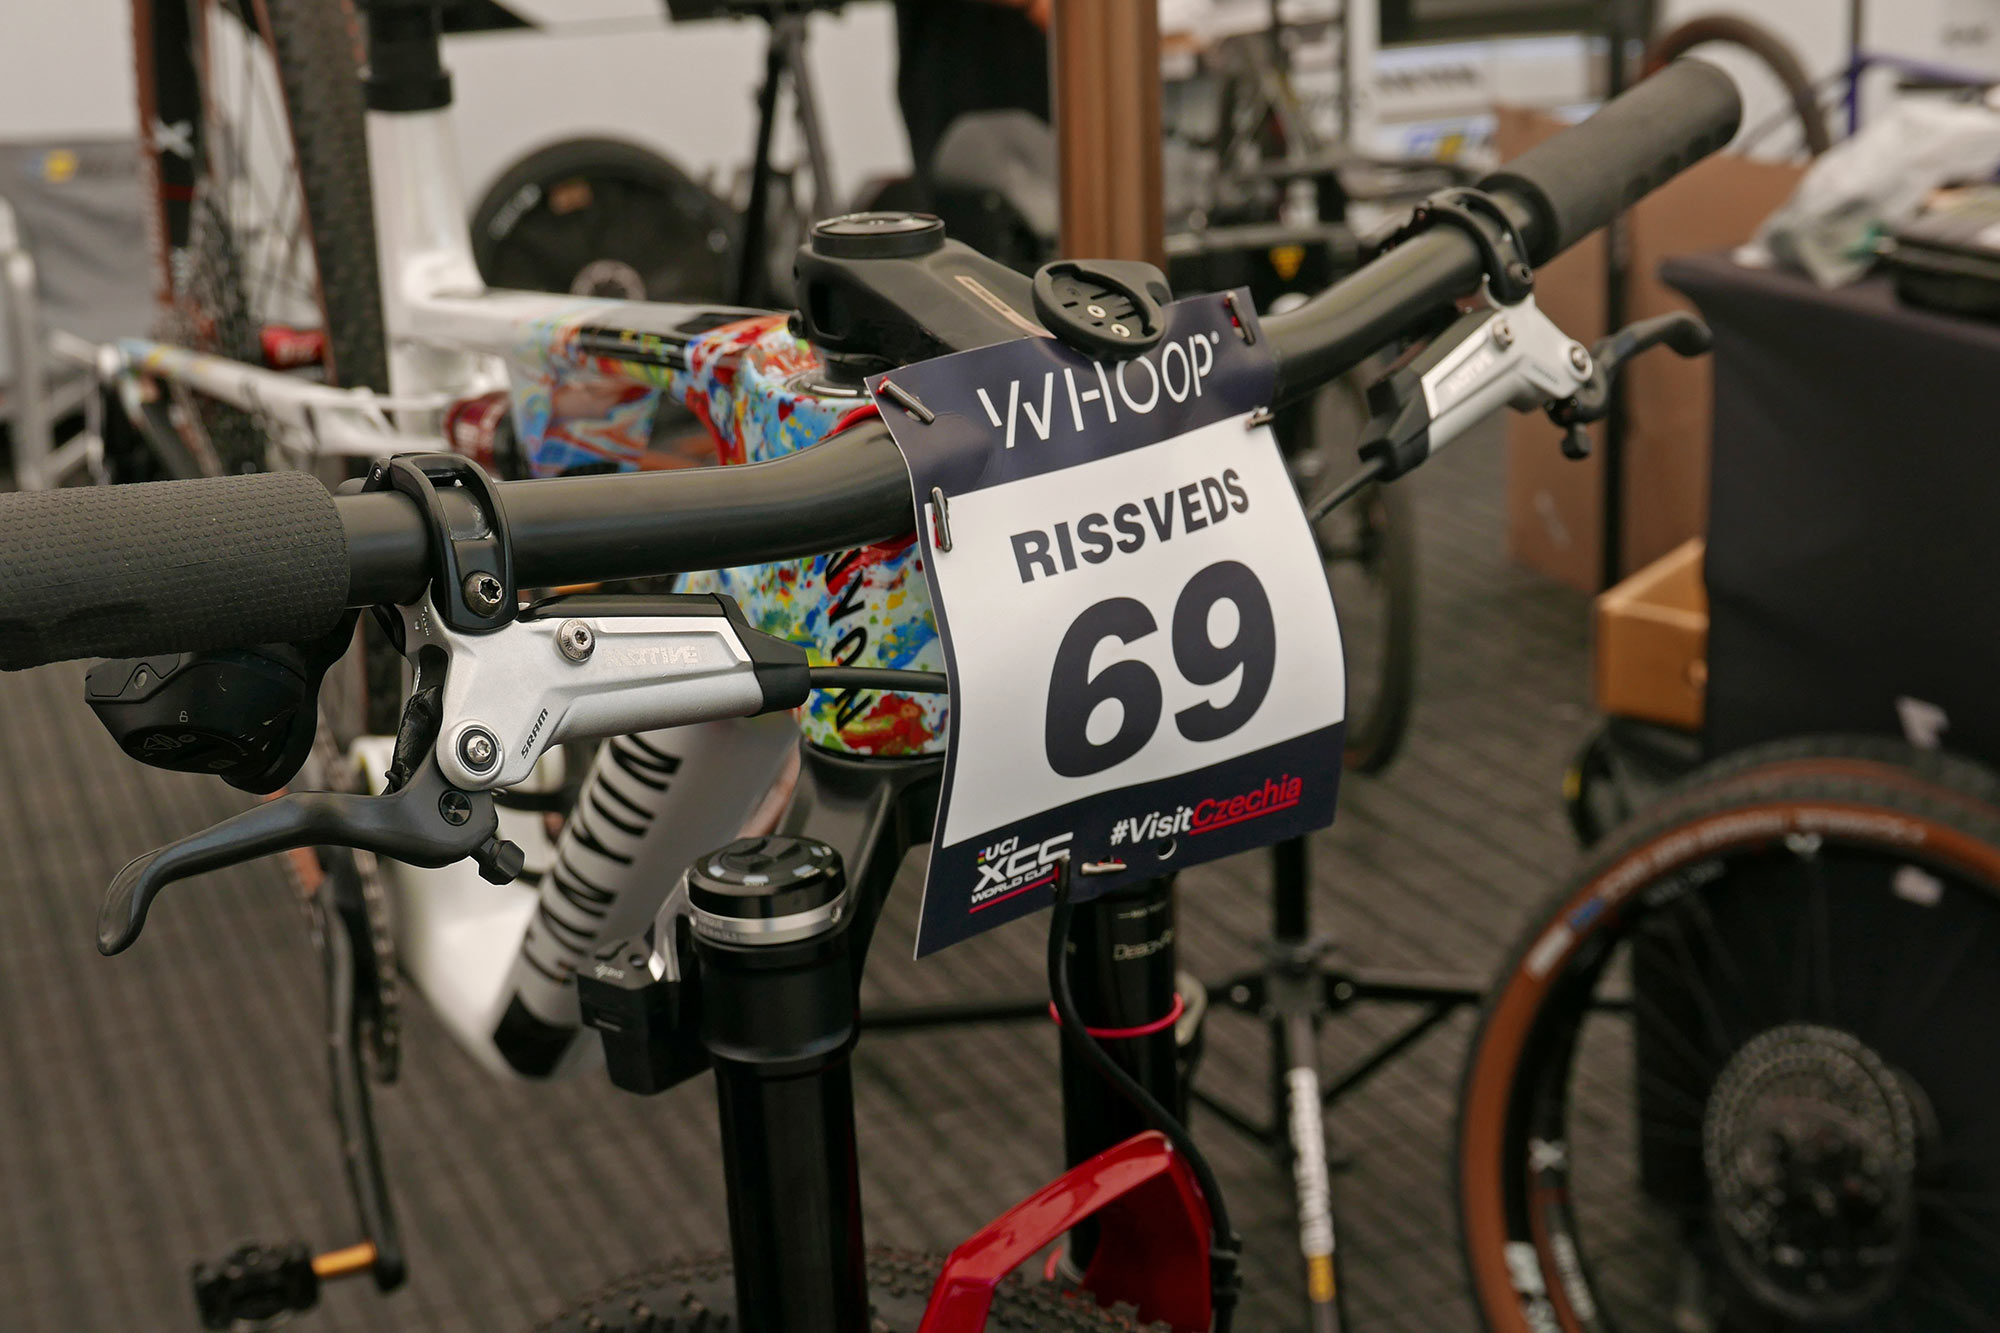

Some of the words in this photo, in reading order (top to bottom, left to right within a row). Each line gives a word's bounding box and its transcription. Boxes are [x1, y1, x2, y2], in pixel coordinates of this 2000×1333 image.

[977, 332, 1214, 448] WHOOP
[1009, 468, 1250, 584] RISSVEDS
[1045, 560, 1276, 778] 69
[520, 707, 549, 759] SRAM
[1110, 773, 1303, 846] #VisitCzechia
[973, 831, 1074, 893] XCC
[985, 836, 1019, 861] UCI
[971, 876, 1023, 904] WORLD
[1024, 863, 1054, 882] CUP
